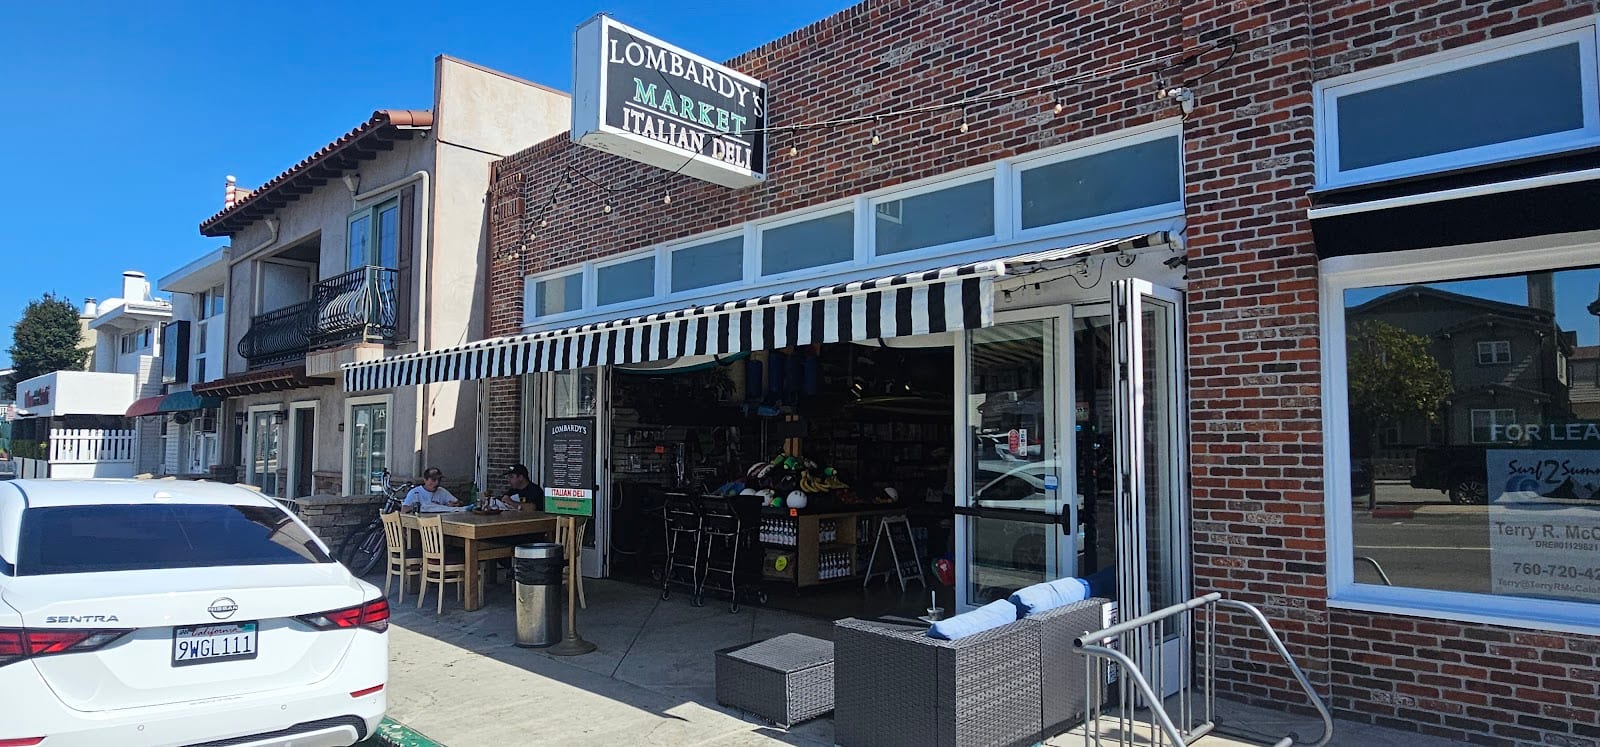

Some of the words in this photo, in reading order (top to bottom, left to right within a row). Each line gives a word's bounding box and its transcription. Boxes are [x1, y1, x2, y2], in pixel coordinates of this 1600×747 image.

[609, 39, 764, 118] LOMBARDY'S
[633, 77, 747, 138] MARKET
[622, 107, 705, 154] ITALIAN
[711, 136, 752, 171] DELI
[552, 424, 587, 435] LOMBARDY'S
[1490, 424, 1541, 441] FOR
[1508, 460, 1542, 481] Surf
[1544, 460, 1561, 484] 2
[552, 488, 572, 497] ITALIAN
[572, 490, 586, 498] DELI
[1496, 522, 1536, 540] Terry
[1542, 524, 1560, 538] R.
[208, 605, 239, 613] NISSAN
[46, 615, 119, 624] SENTRA
[191, 625, 239, 637] California
[178, 635, 252, 660] 9WGL111
